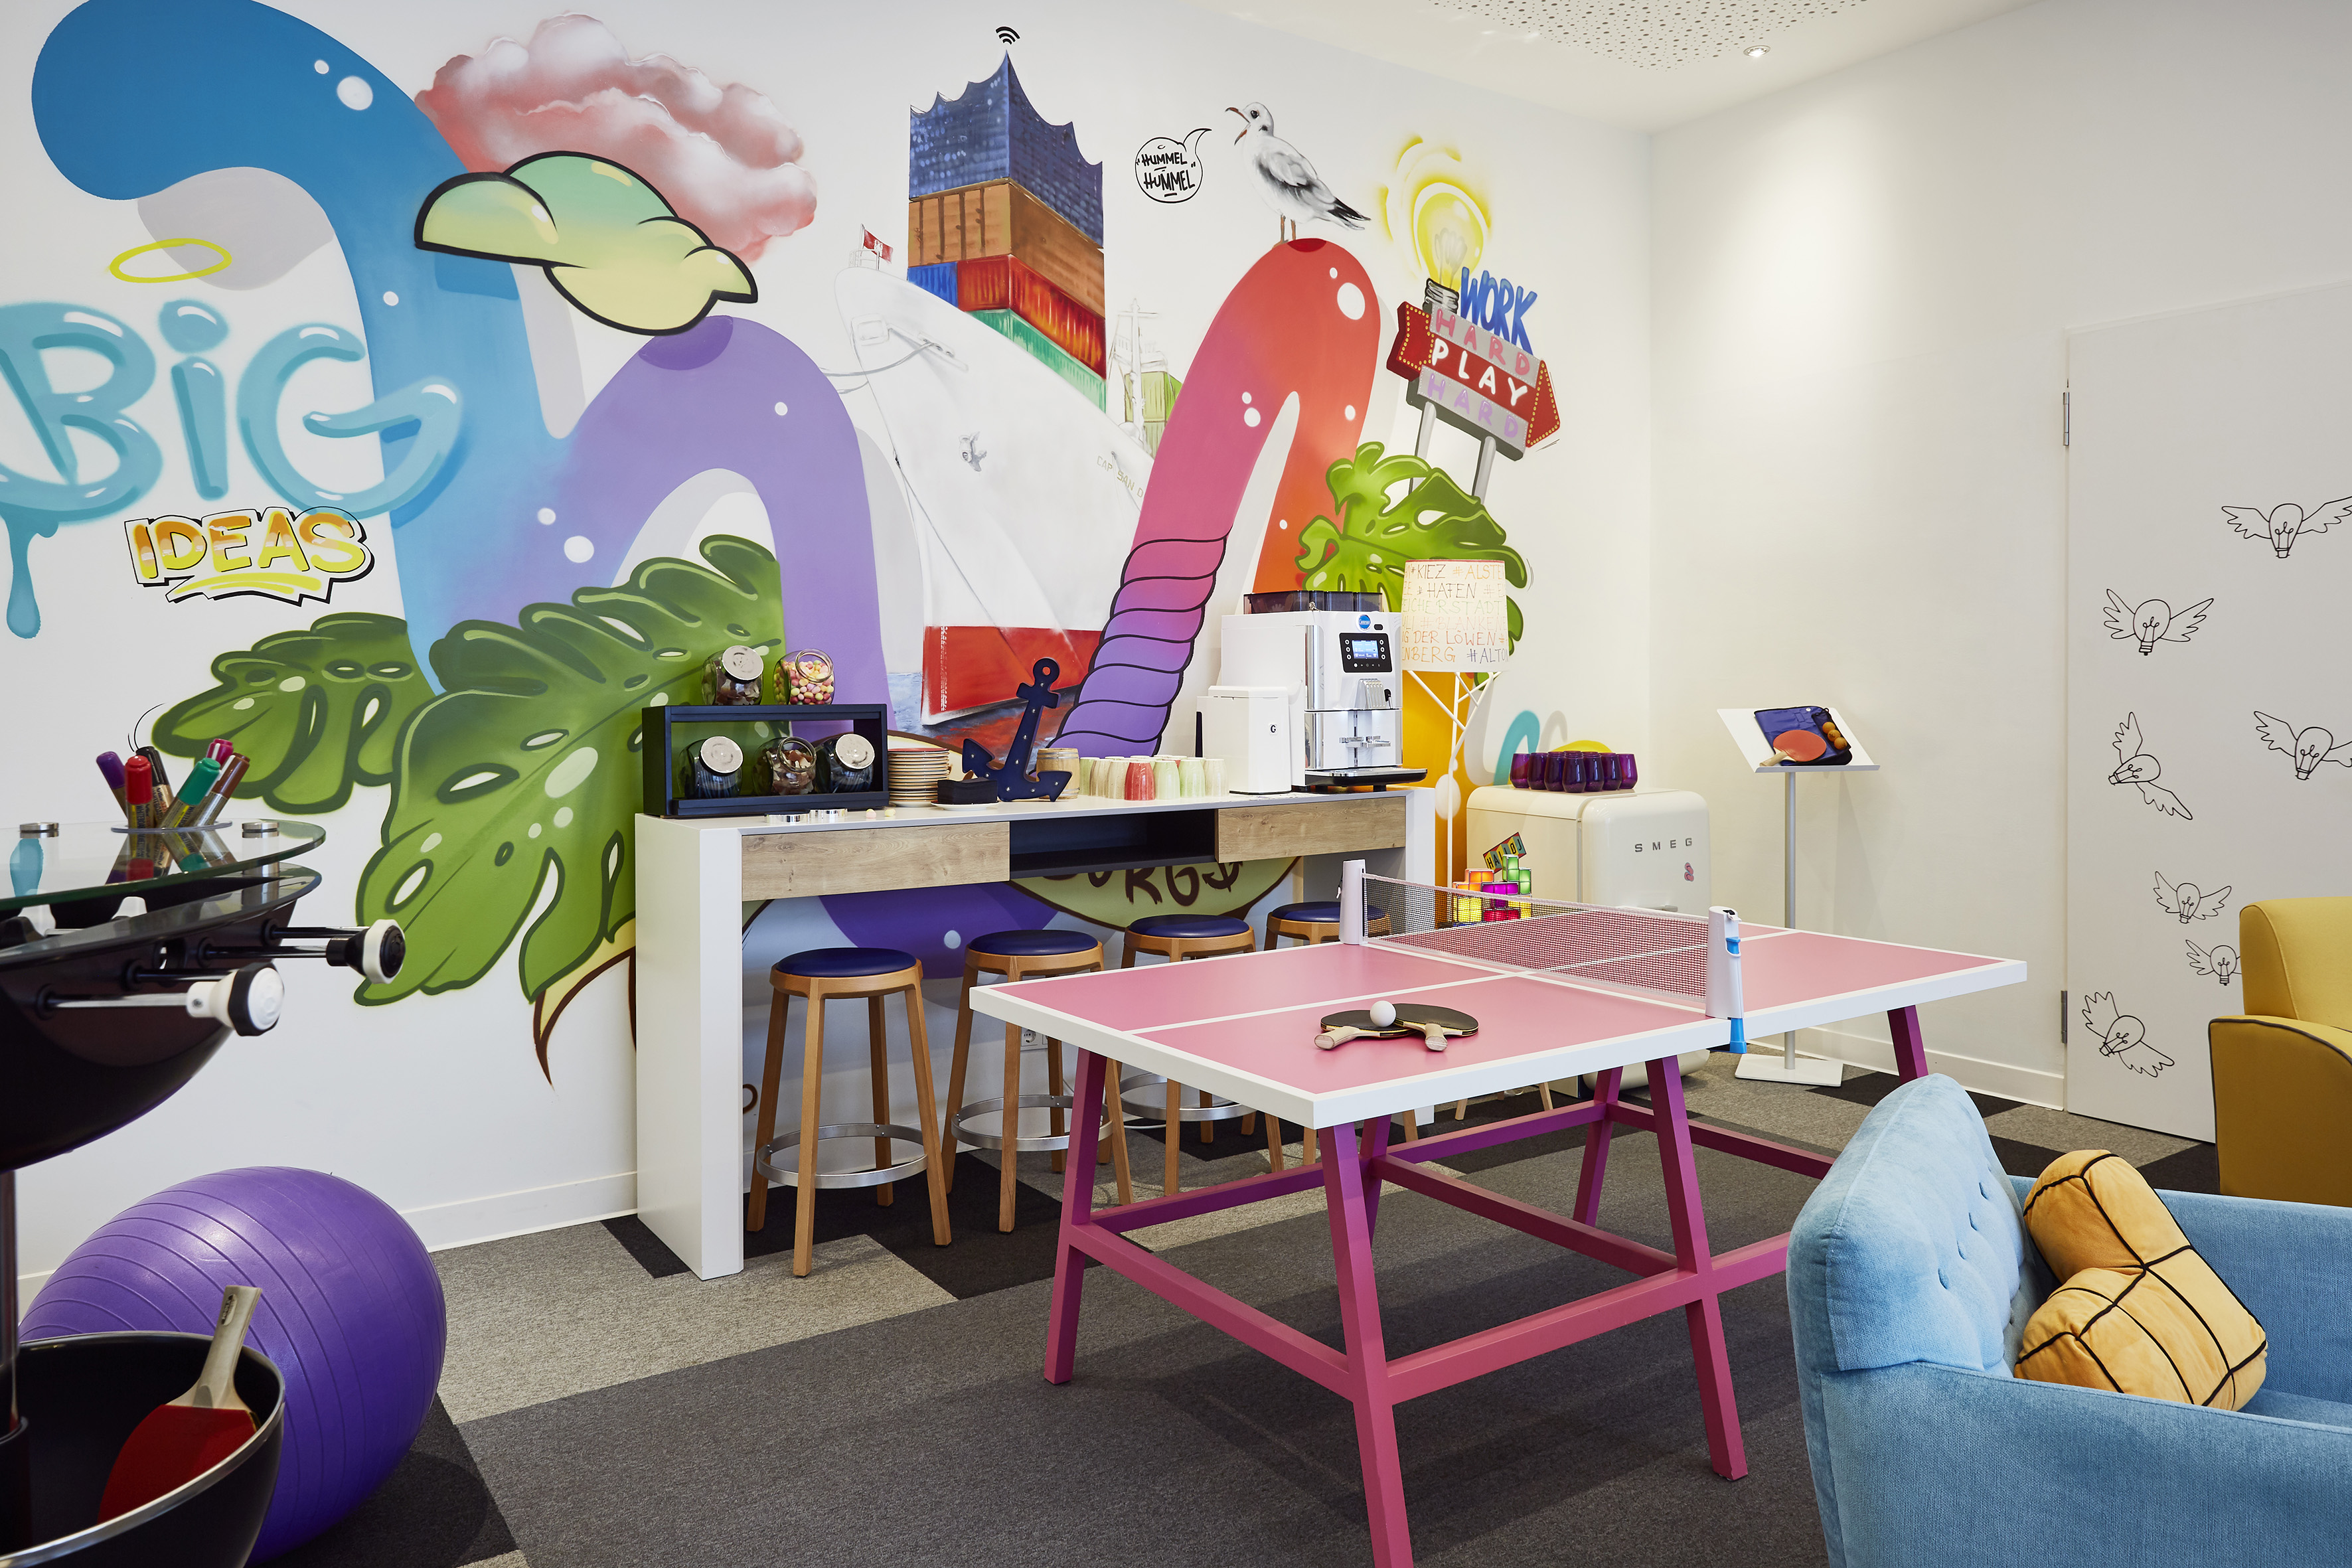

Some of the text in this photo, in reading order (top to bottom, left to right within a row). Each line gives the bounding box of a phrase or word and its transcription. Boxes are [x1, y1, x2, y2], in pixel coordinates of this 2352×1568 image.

[1435, 308, 1530, 376] HARD
[1460, 266, 1537, 356] WORK
[1427, 372, 1519, 438] HARD
[1431, 337, 1528, 406] PLAY
[1097, 455, 1113, 471] CAP
[1117, 469, 1135, 491] SAN
[131, 508, 369, 581] IDEAS
[1413, 630, 1440, 644] DER
[1446, 629, 1496, 646] LÖWEN
[1634, 837, 1693, 852] SMEG
